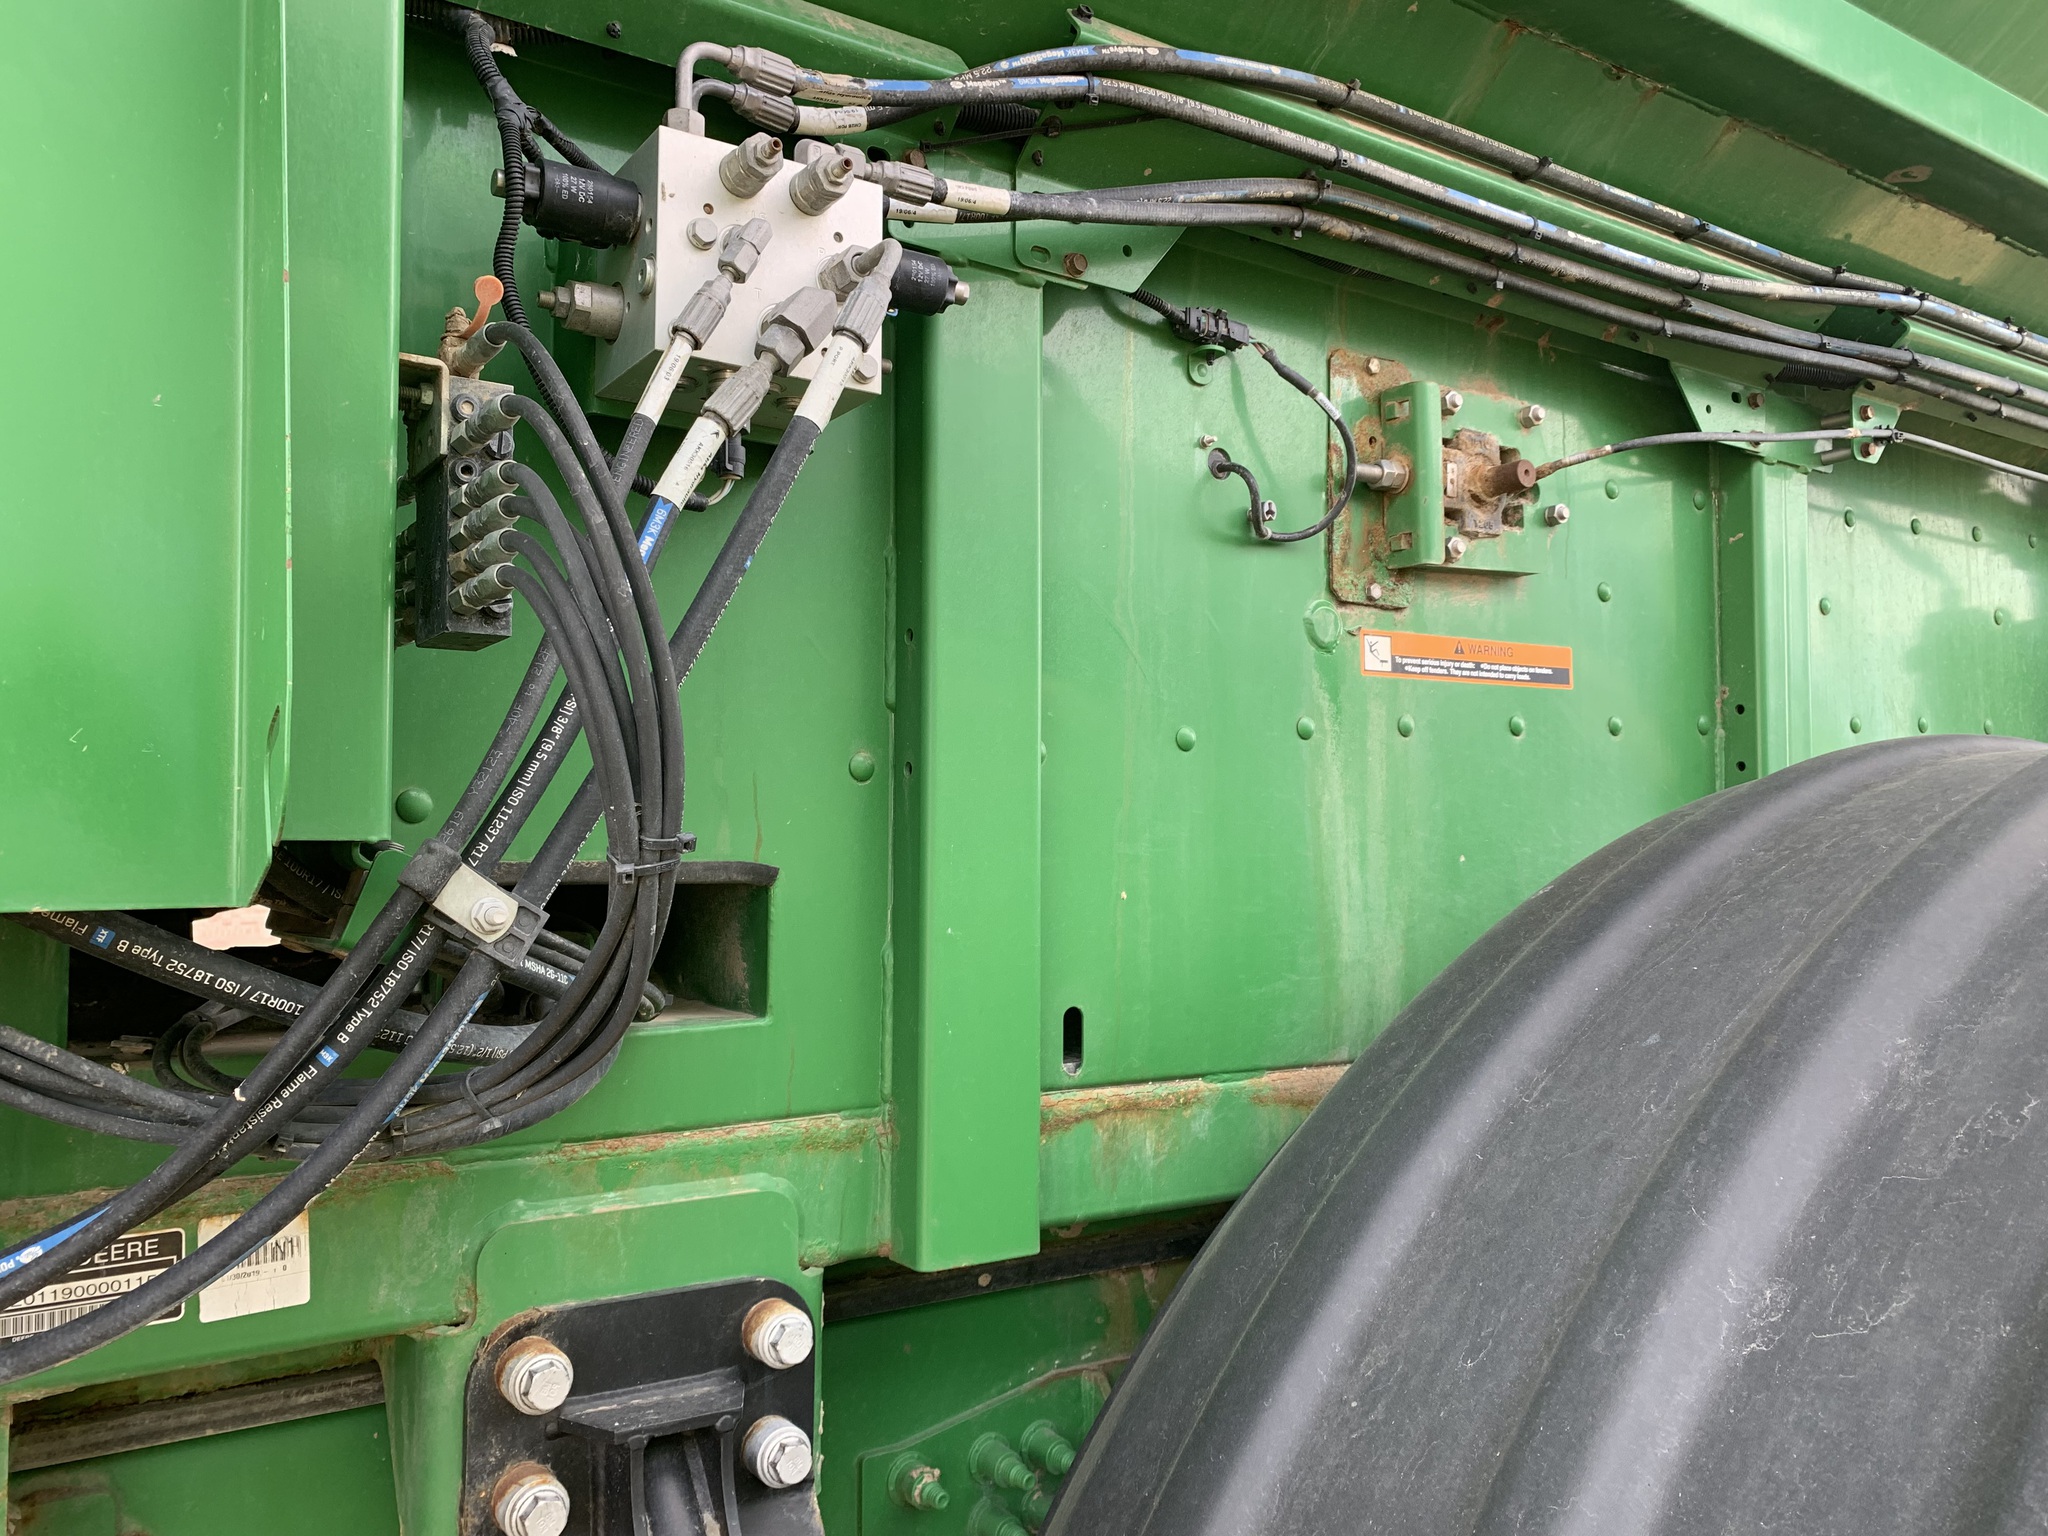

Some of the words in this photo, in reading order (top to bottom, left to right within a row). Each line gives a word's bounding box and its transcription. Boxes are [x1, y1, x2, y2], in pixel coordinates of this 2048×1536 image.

[570, 175, 578, 185] 27
[578, 190, 586, 203] DC
[613, 417, 644, 484] ENGINEERED
[647, 506, 668, 540] 6M3K
[1468, 643, 1515, 658] WARNING
[1394, 656, 1402, 664] To
[1402, 657, 1421, 665] prevent
[1421, 658, 1440, 667] serious
[1440, 659, 1454, 669] injury
[505, 703, 524, 733] -40F
[524, 683, 536, 696] to
[517, 760, 541, 787] mm)
[507, 785, 527, 807] ISO
[484, 804, 514, 842] 11237
[468, 840, 490, 868] R17
[95, 928, 109, 944] XTF
[116, 939, 130, 953] B
[131, 945, 164, 968] Type
[396, 949, 418, 972] ISO
[524, 959, 546, 976] MSHA
[165, 958, 215, 985] 18752
[214, 977, 241, 995] ISO
[367, 970, 402, 1009] 18752
[249, 990, 305, 1016] 100R17
[345, 1007, 374, 1033] Type
[336, 1032, 350, 1045] B
[319, 1049, 335, 1063] M3K
[280, 1064, 319, 1099] Flame
[81, 1238, 160, 1266] EERE
